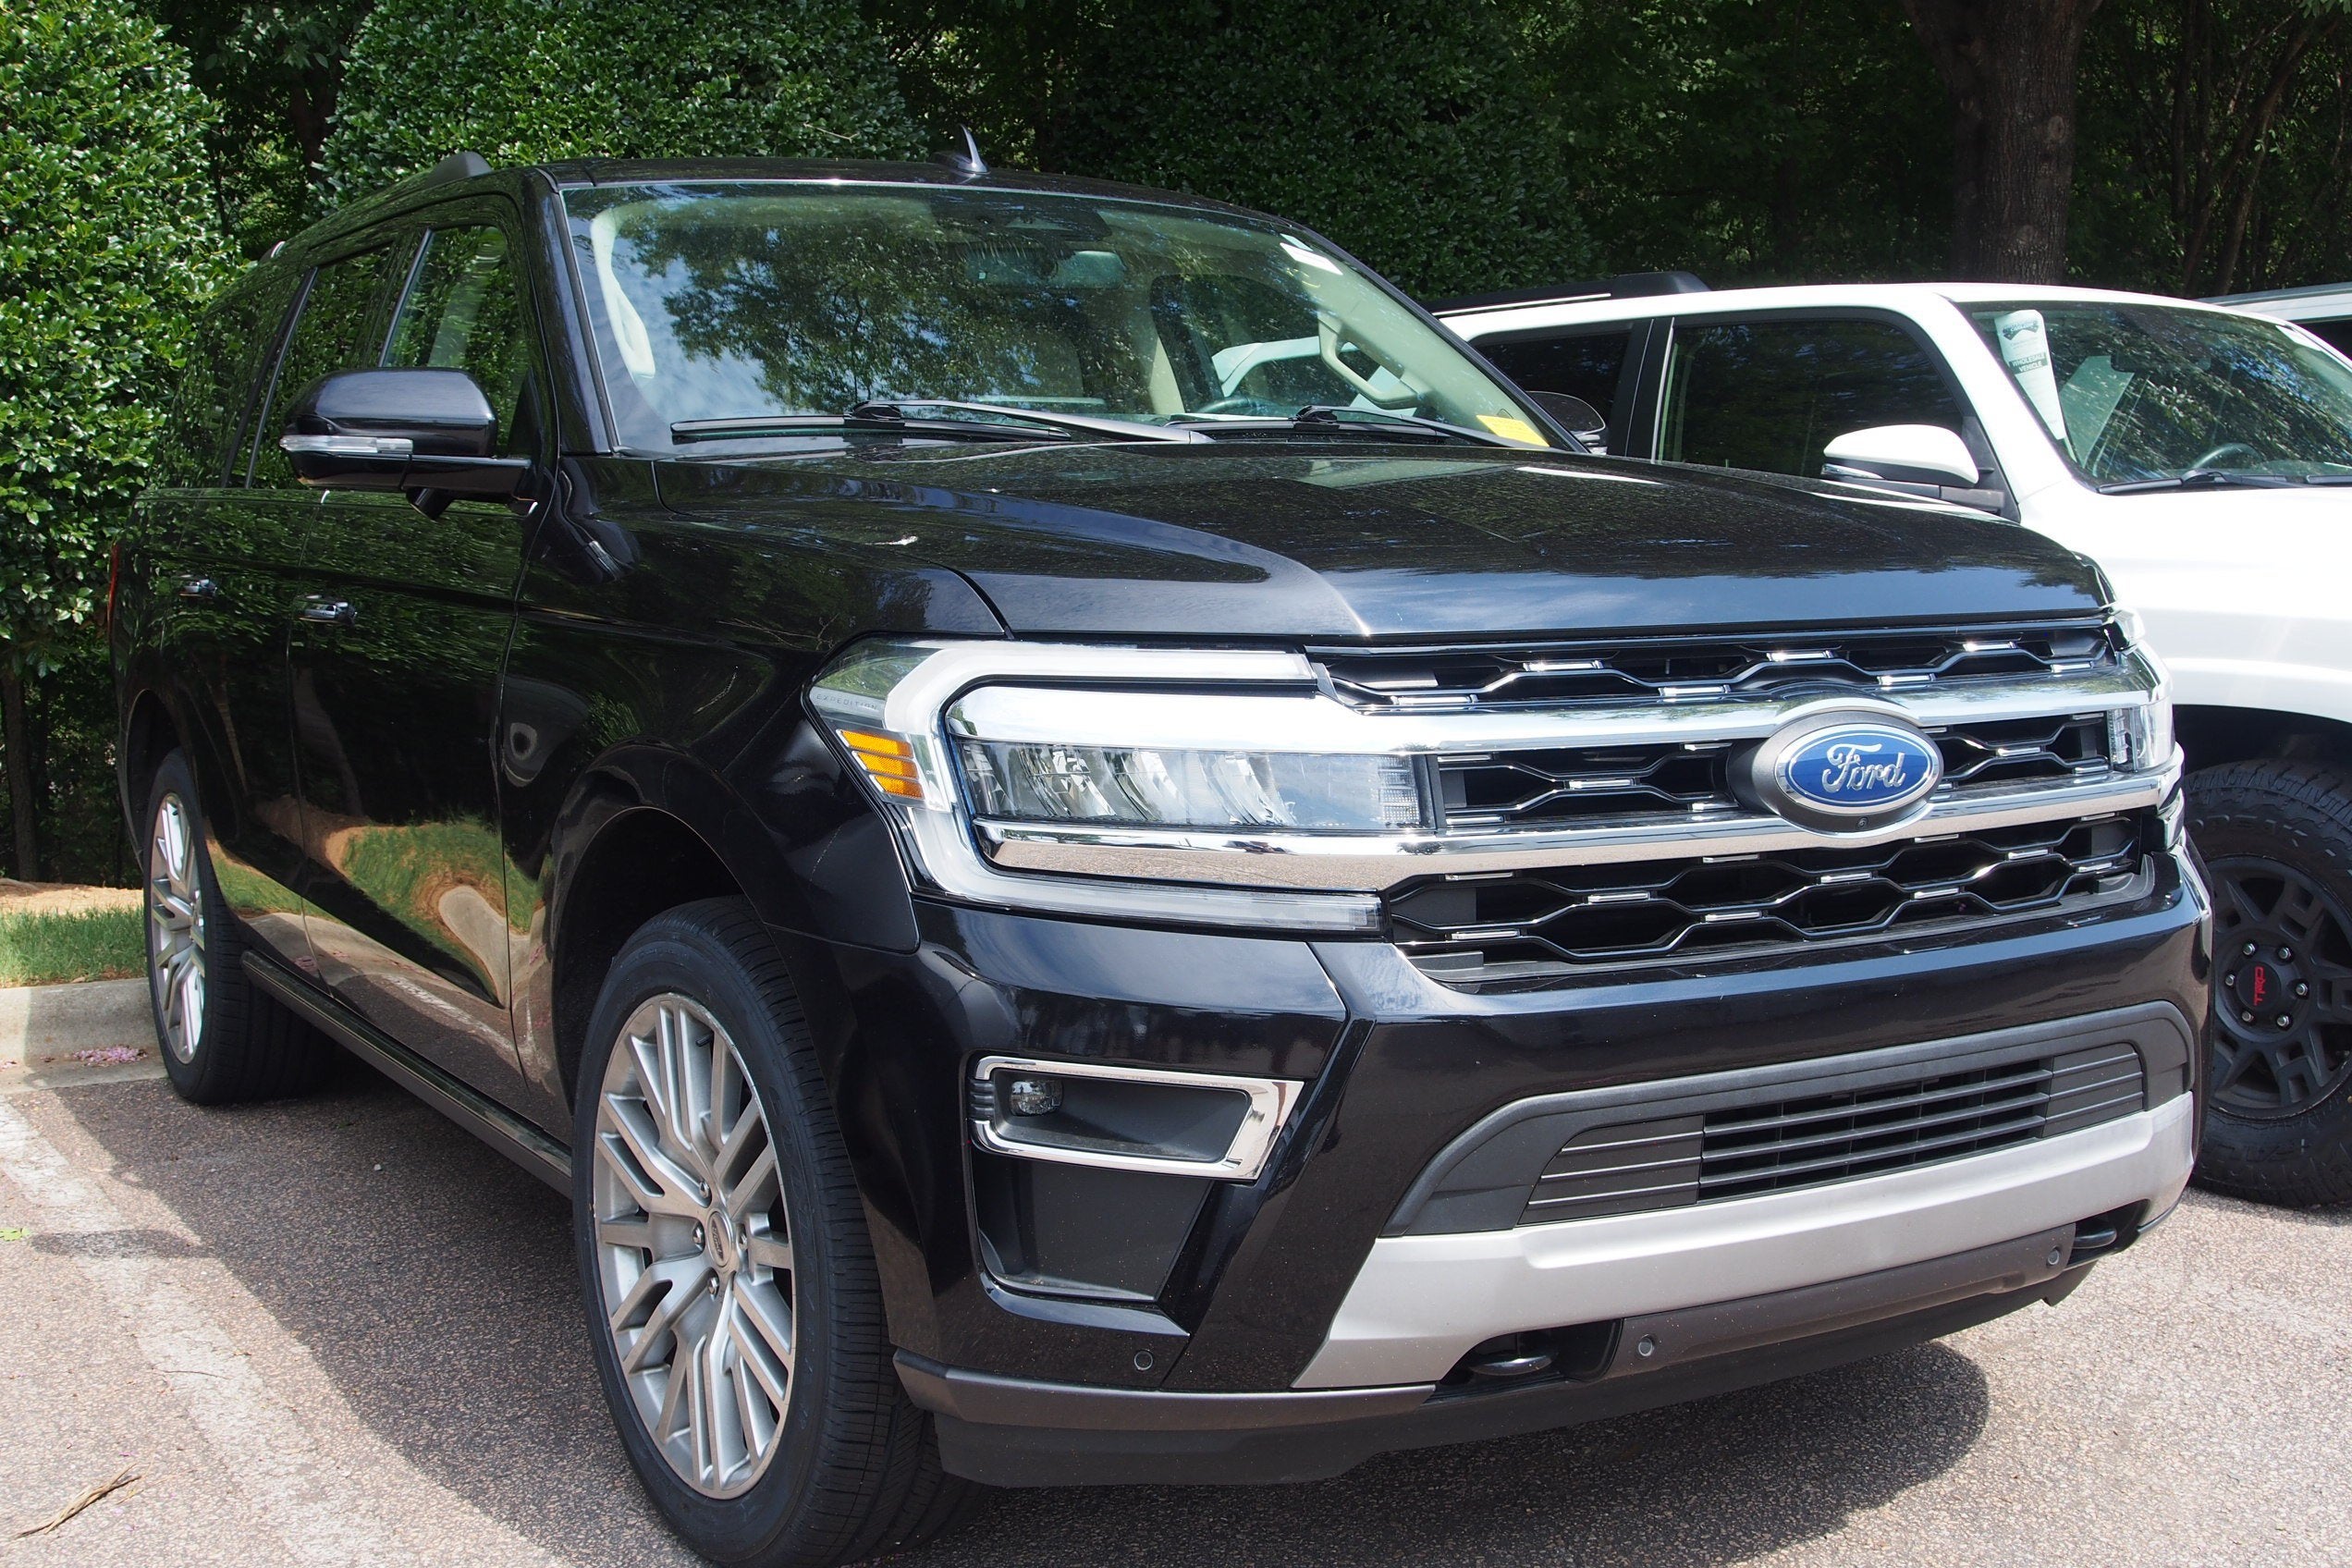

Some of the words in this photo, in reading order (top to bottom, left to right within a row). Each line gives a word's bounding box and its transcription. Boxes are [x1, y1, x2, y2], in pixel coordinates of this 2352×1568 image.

[2018, 360, 2042, 373] VEHICLE
[816, 693, 877, 710] EXPEDITION
[1821, 742, 1906, 793] Ford
[2253, 965, 2266, 1006] TRD
